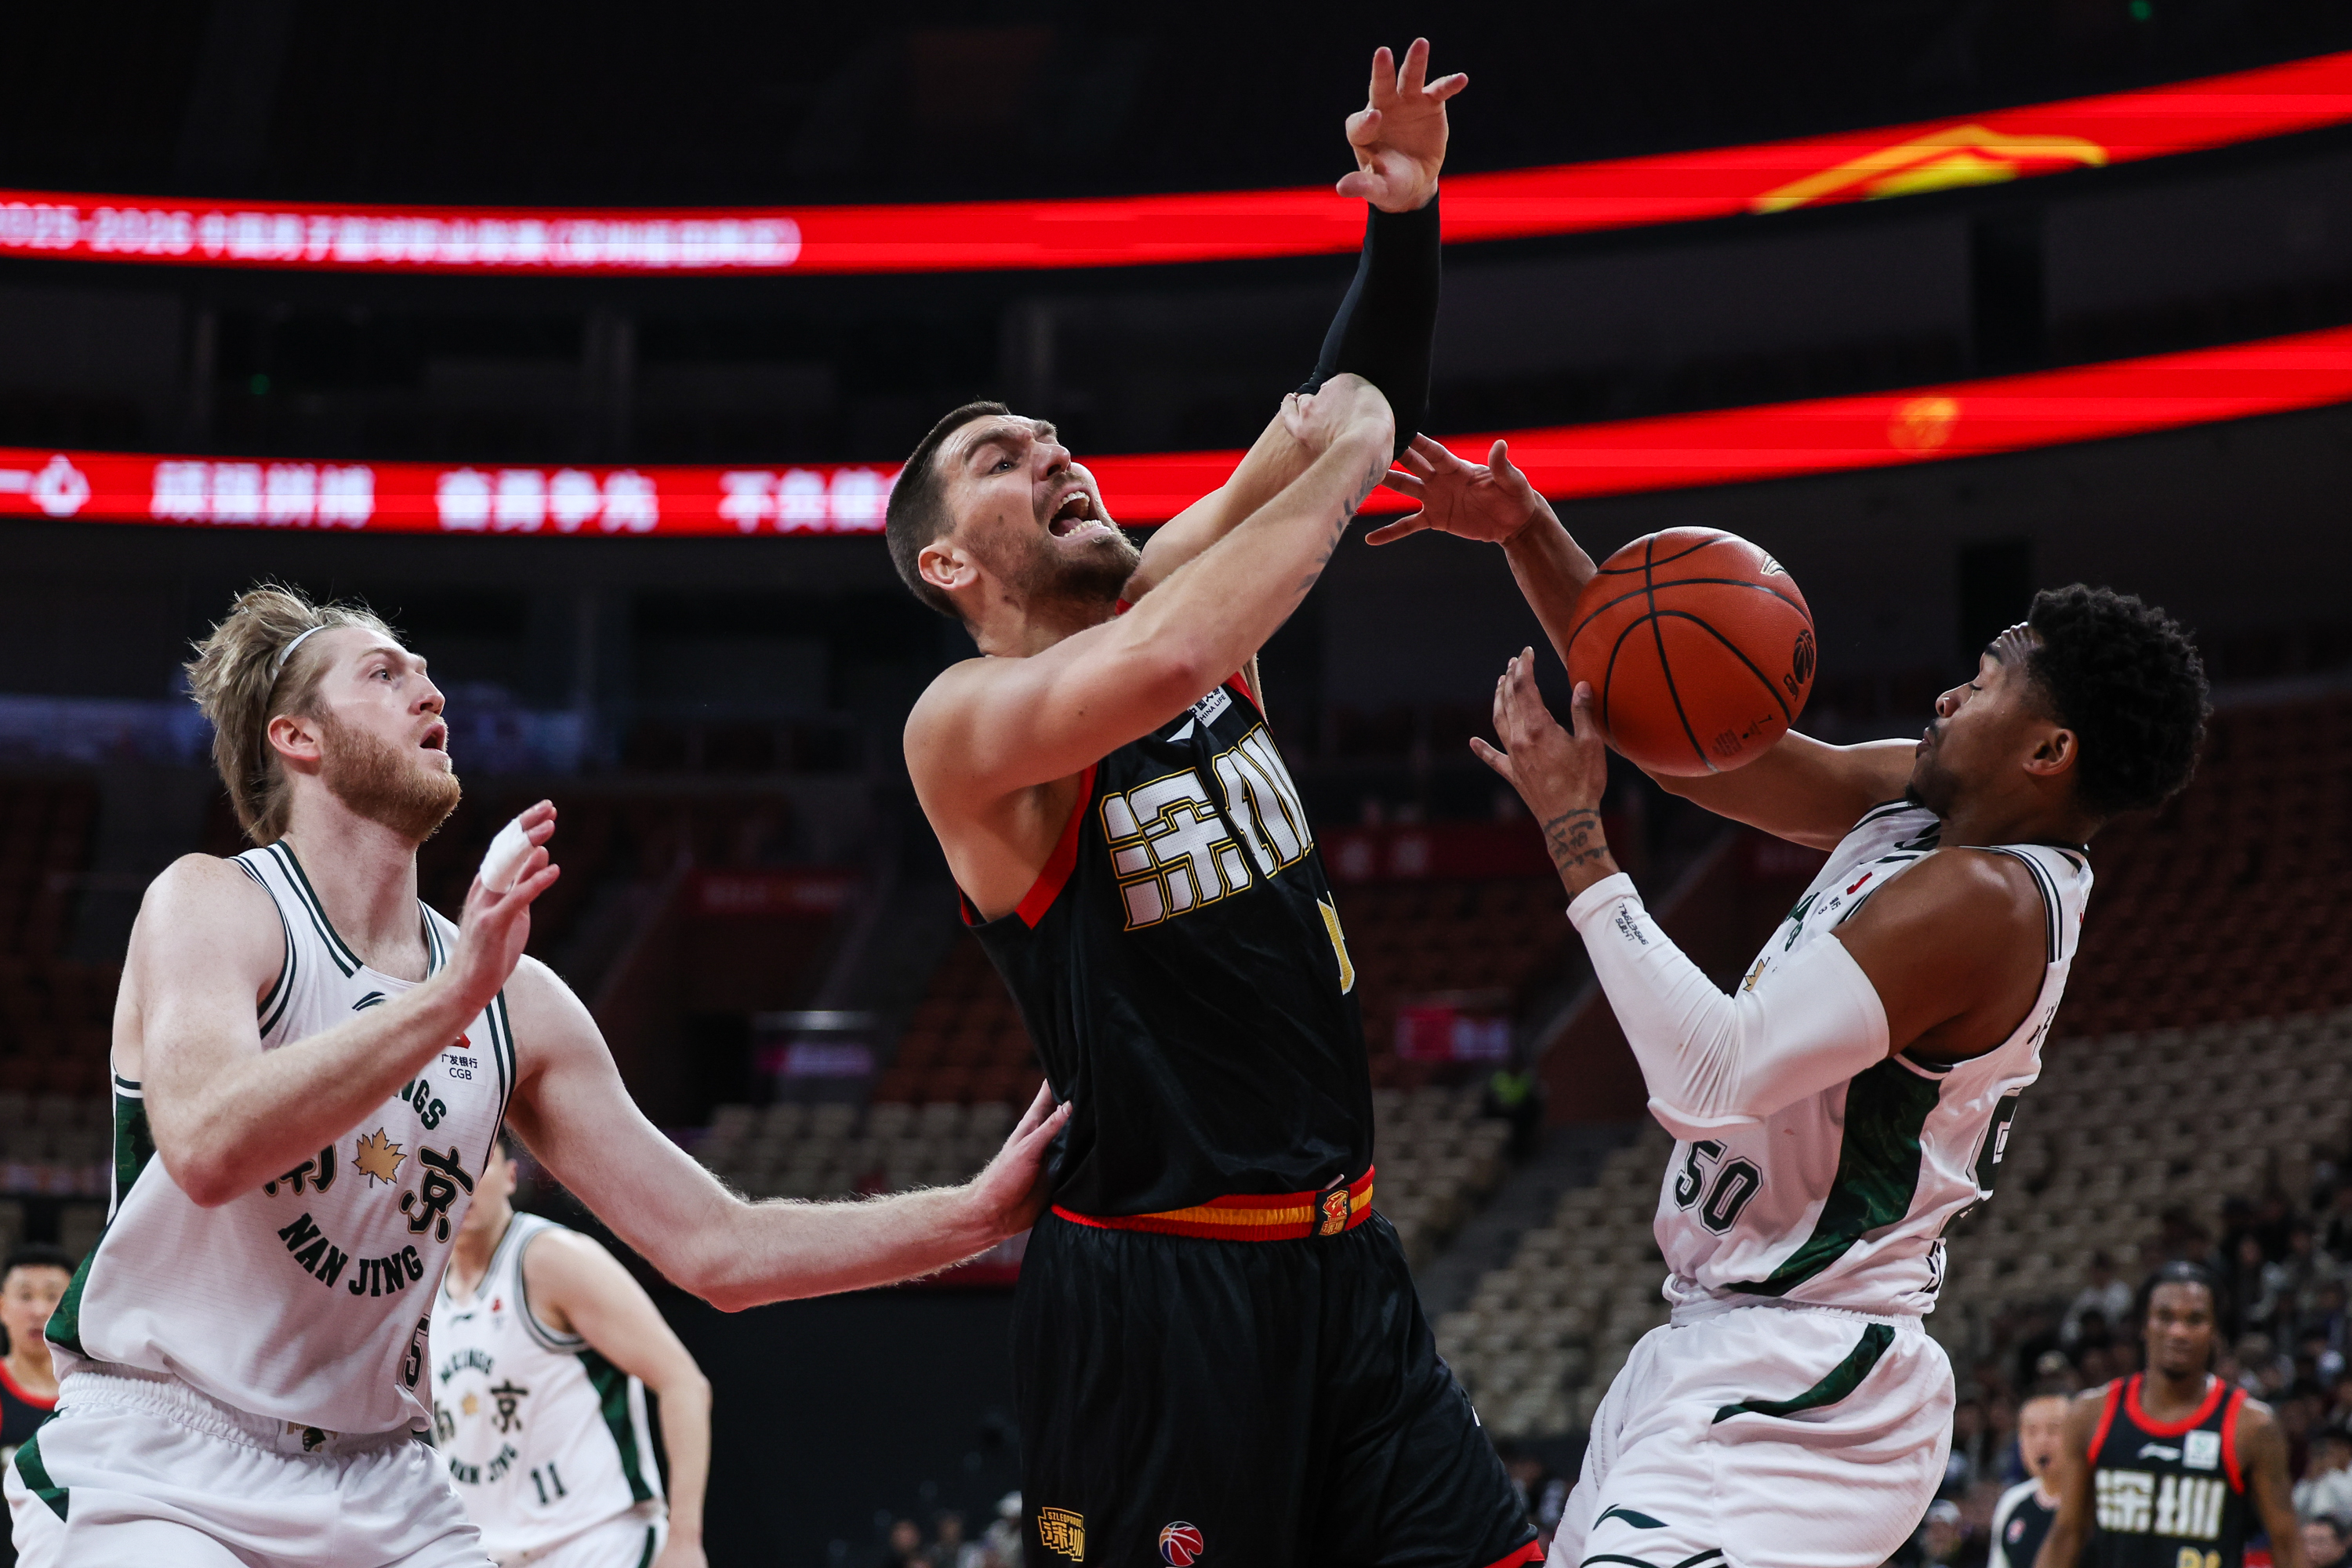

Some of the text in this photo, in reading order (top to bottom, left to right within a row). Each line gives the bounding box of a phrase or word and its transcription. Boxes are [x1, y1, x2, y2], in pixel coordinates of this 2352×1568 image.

[1199, 694, 1226, 721] HINA LIFE
[1099, 721, 1313, 931] 深圳
[441, 1053, 478, 1069] 广发银行
[449, 1067, 472, 1080] CGB
[1673, 1138, 1764, 1236] 50
[278, 1212, 423, 1297] NAN JING
[531, 1462, 568, 1505] 11
[2094, 1468, 2228, 1541] 深圳
[1043, 1521, 1084, 1557] 深圳
